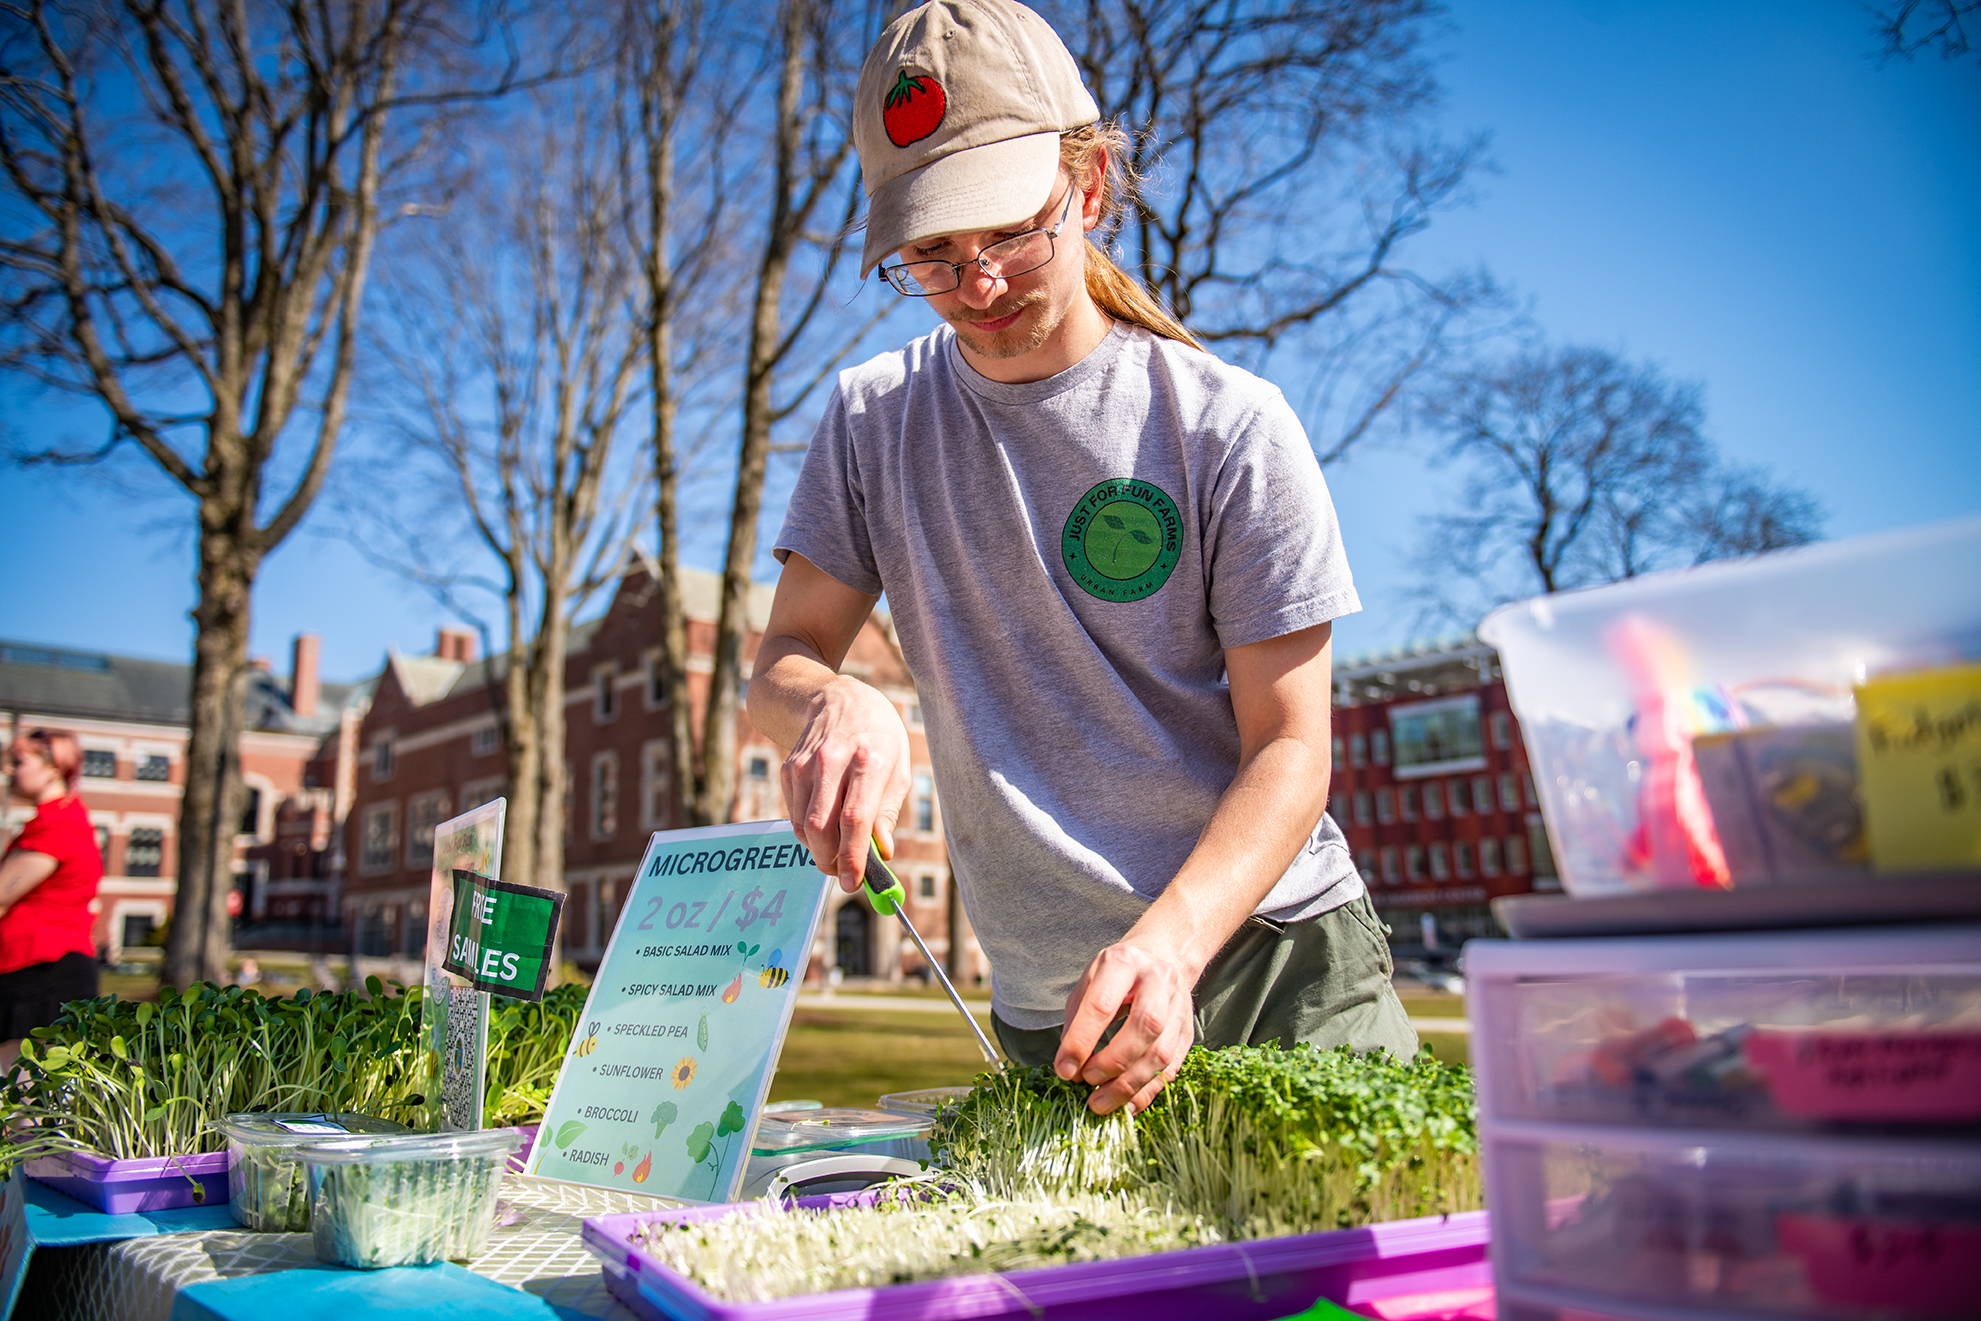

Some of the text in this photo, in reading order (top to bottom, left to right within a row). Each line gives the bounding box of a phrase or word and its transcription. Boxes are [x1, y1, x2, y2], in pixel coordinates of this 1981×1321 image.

[1069, 484, 1178, 552] JUST FOR FUN FARMS
[1080, 574, 1154, 596] URBAN FARM
[637, 886, 787, 933] 2 oz / $4
[643, 945, 732, 957] BASIC SALAD MIX
[628, 984, 717, 996] SPICY SALAD MIX
[614, 1023, 688, 1038] SPECKLED PEA
[600, 1064, 663, 1080] SUNFLOWER
[584, 1106, 639, 1123] BROCCOLI
[569, 1149, 610, 1166] RADISH
